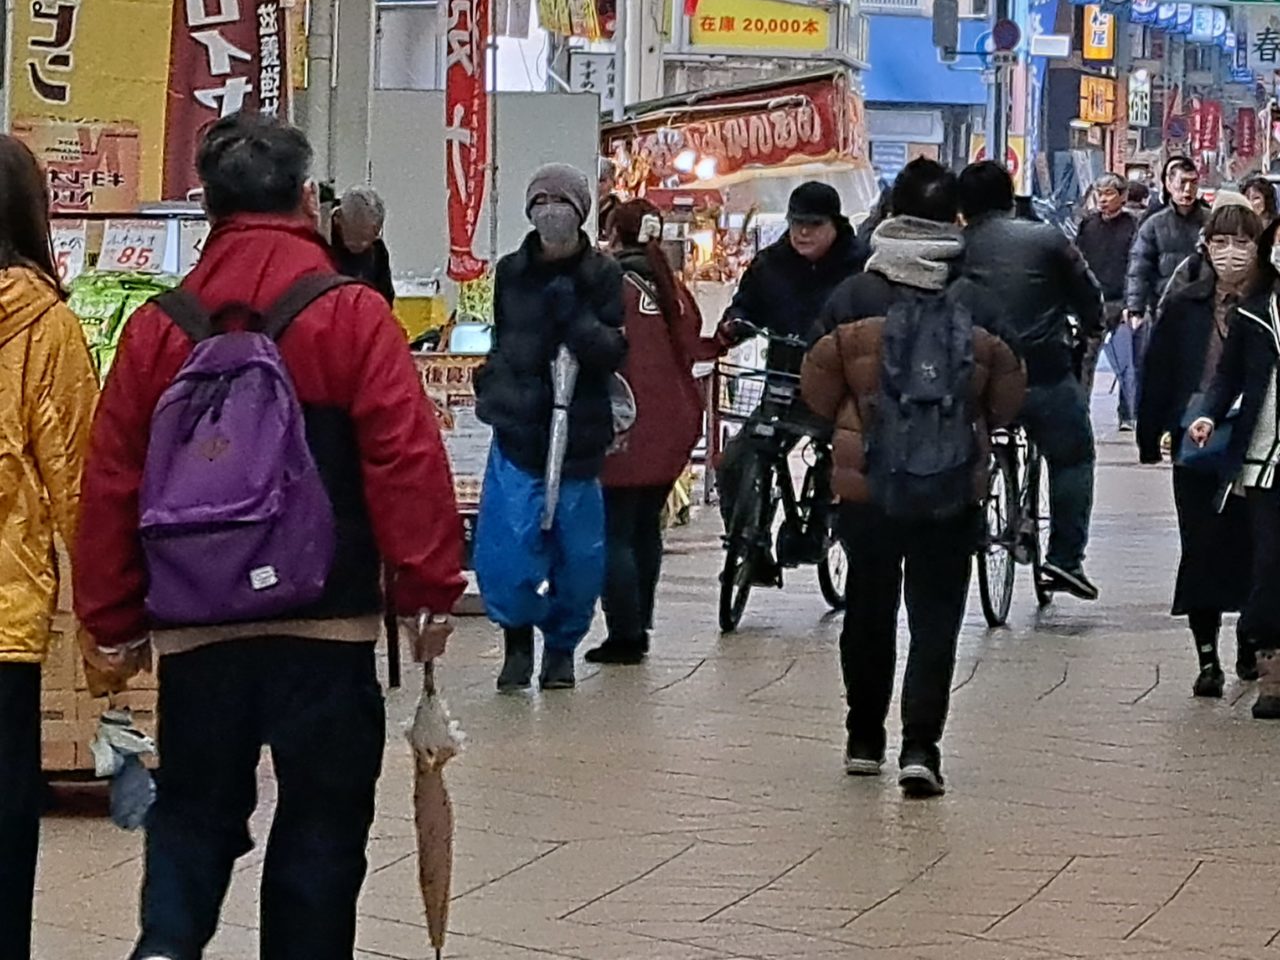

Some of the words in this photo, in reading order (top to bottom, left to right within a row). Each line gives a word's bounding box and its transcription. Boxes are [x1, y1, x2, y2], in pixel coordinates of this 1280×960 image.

[700, 15, 735, 32] 在庫
[742, 16, 820, 35] 20,000本
[117, 245, 154, 267] 85
